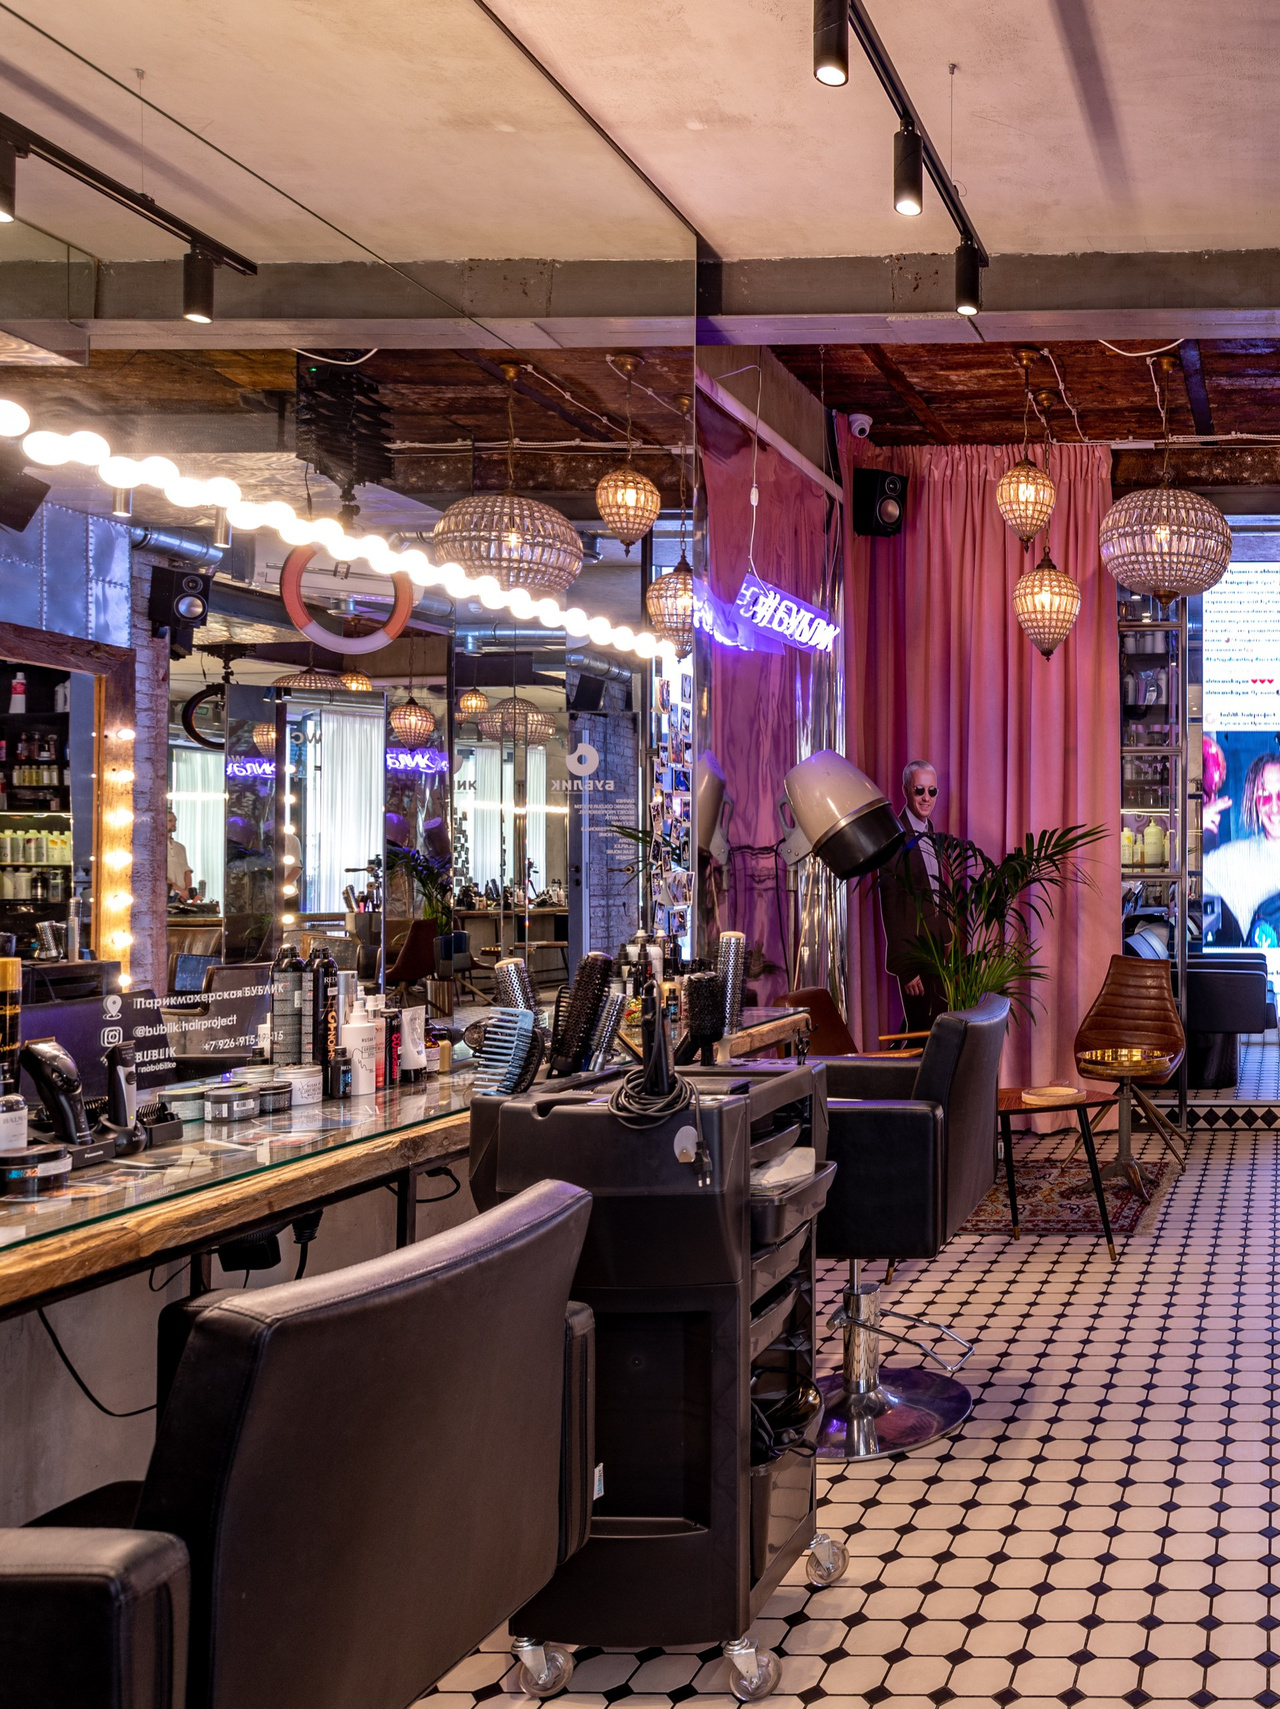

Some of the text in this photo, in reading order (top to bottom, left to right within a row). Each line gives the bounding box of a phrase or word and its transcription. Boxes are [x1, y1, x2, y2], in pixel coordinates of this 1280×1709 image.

[133, 983, 284, 1010] Парикмахерская БУБЛИК
[135, 1046, 177, 1063] BUBLIK
